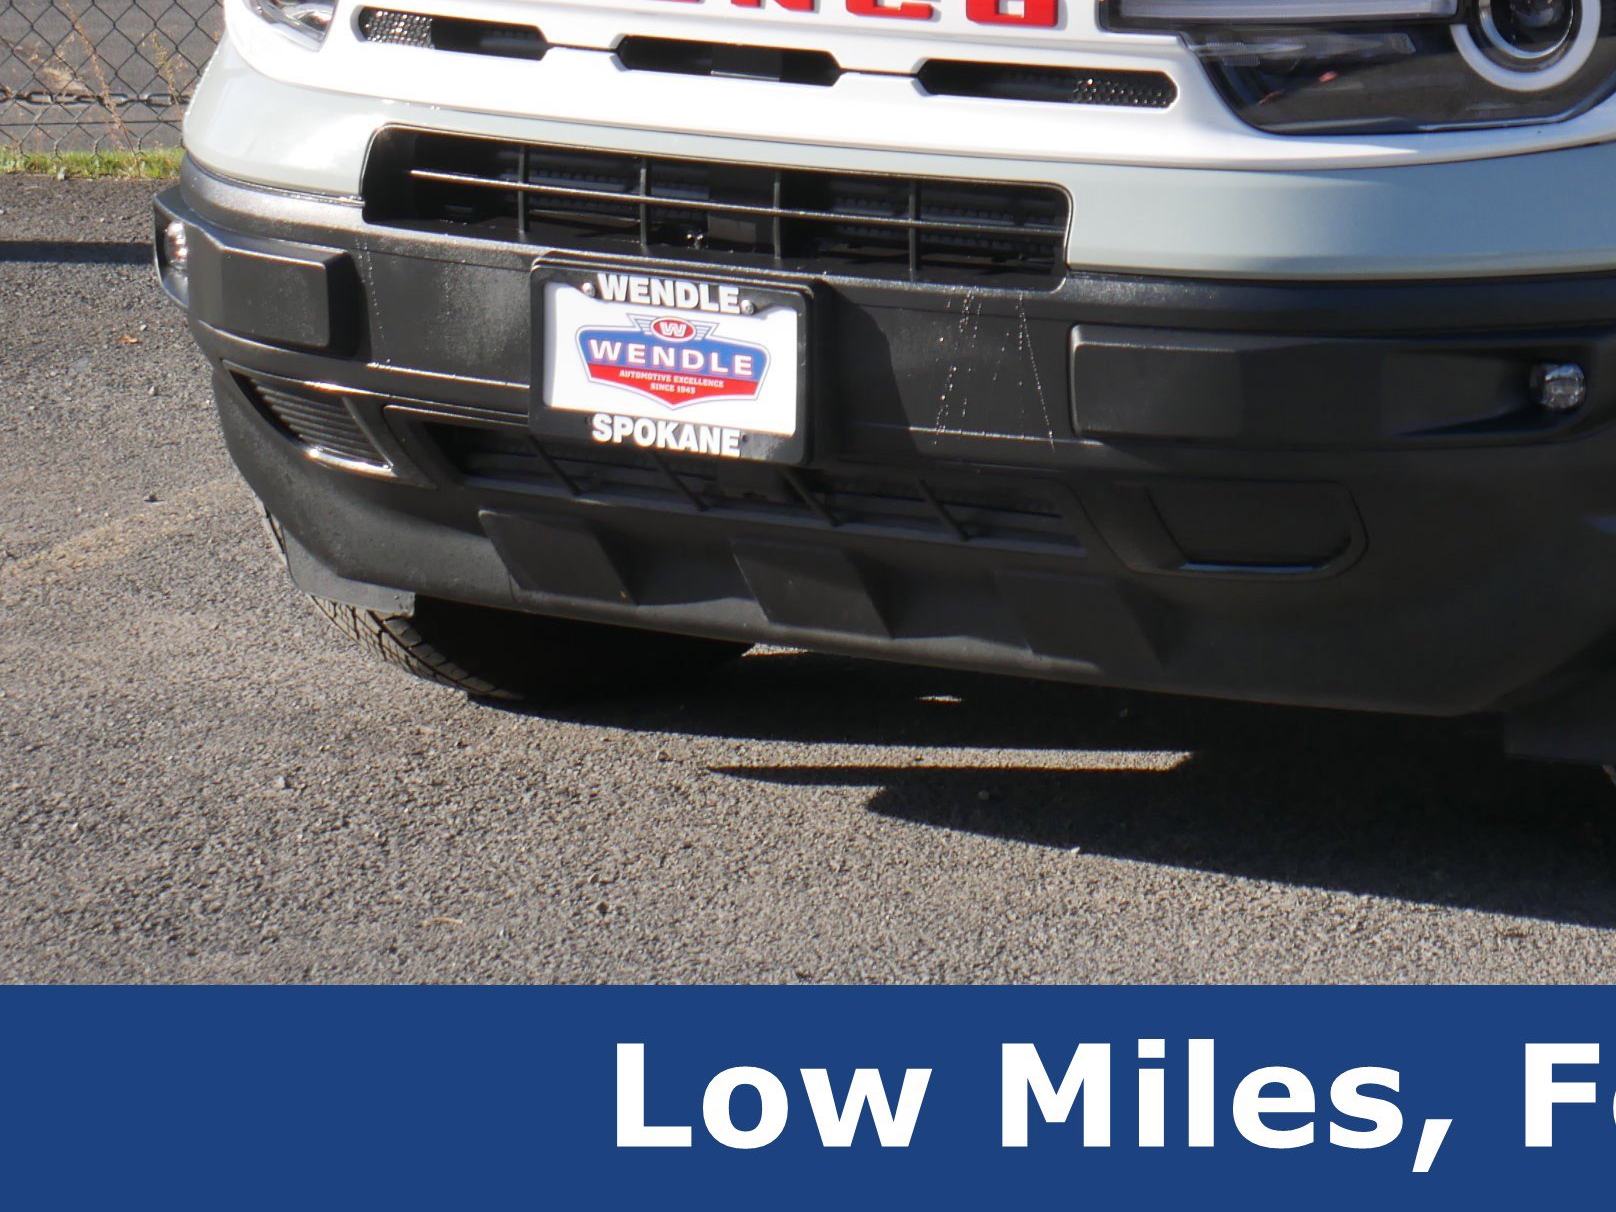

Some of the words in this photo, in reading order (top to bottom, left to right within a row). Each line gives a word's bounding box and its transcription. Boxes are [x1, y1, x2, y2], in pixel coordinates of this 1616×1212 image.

[597, 273, 741, 314] WENDLE
[589, 339, 753, 376] WENDLE
[619, 369, 672, 383] AUTOMOTIVE
[673, 375, 725, 388] EXCELLENCE
[650, 382, 676, 393] SINCE
[592, 413, 741, 457] SPOKANE
